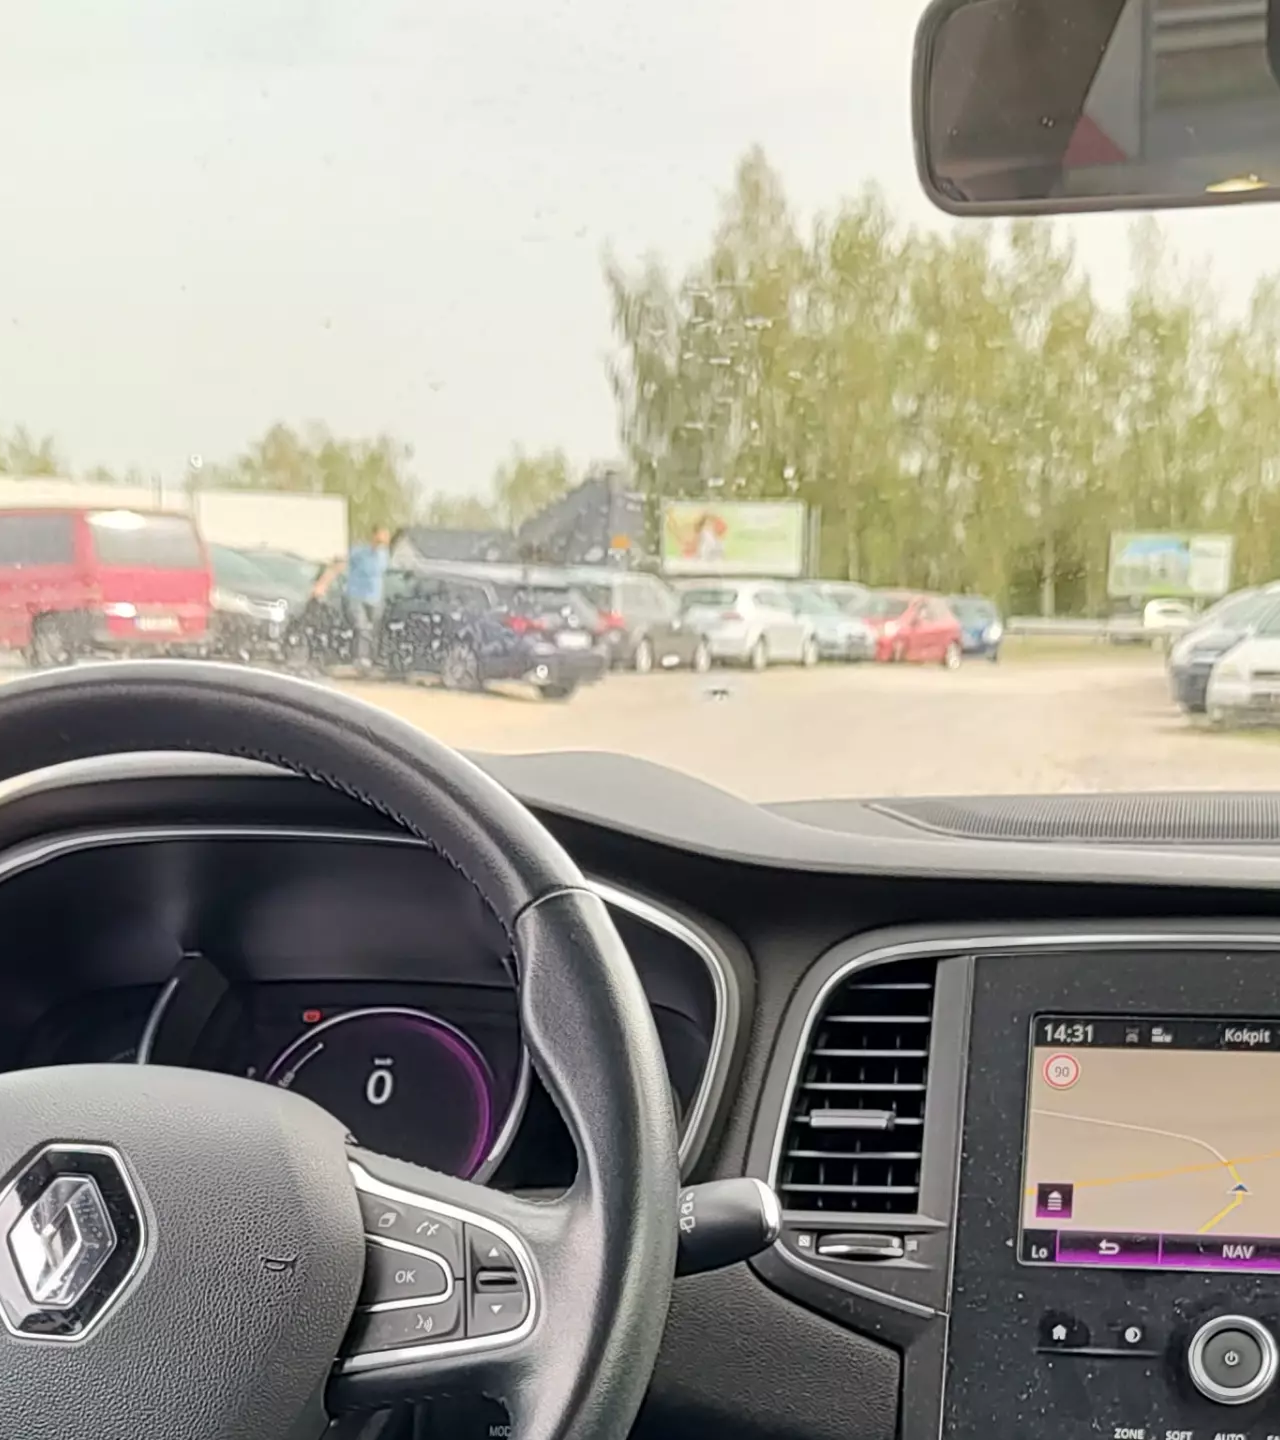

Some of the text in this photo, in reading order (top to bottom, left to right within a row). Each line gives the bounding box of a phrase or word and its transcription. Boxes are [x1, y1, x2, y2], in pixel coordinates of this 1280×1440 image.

[1044, 1023, 1094, 1043] 14:31
[1224, 1027, 1271, 1046] Kokpit
[1054, 1065, 1070, 1078] 90
[366, 1069, 393, 1105] 0
[1031, 1244, 1048, 1259] Lo
[1222, 1243, 1254, 1260] NAV
[394, 1269, 417, 1284] OK
[489, 1425, 511, 1437] MOD
[1114, 1427, 1146, 1440] ZONE
